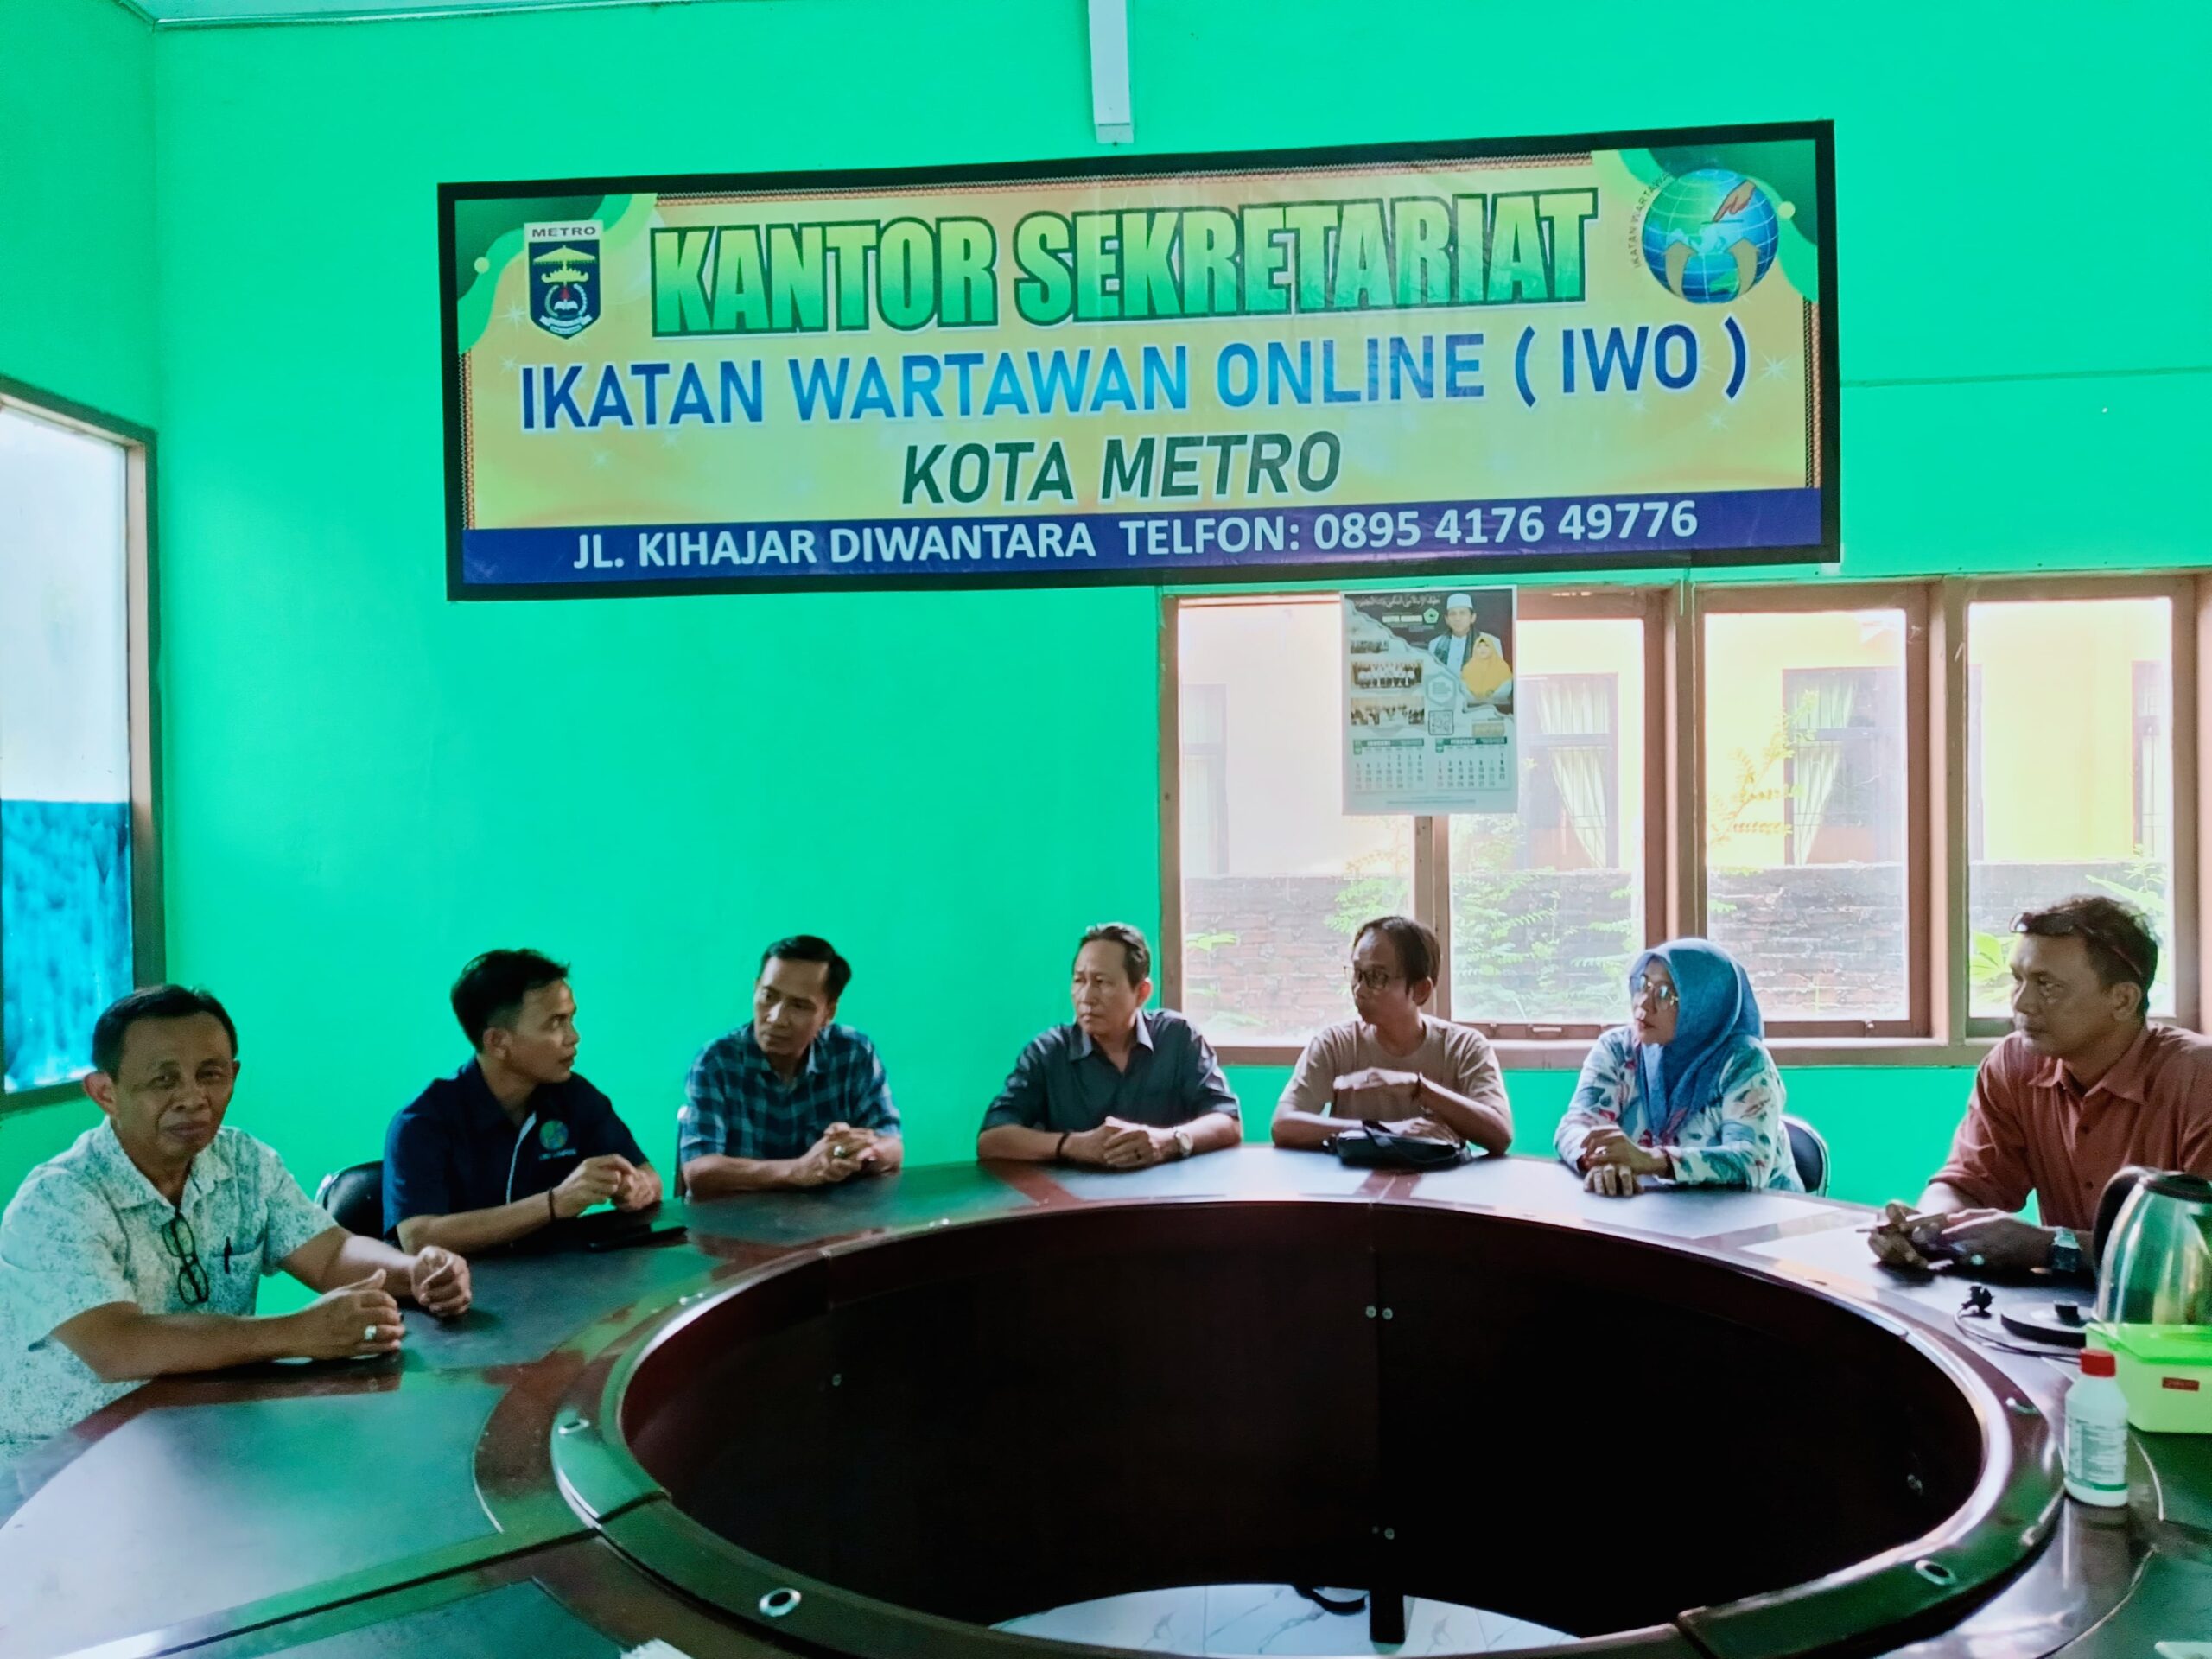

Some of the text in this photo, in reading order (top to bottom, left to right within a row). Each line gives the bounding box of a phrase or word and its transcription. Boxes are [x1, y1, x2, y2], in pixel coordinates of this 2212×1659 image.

[532, 226, 596, 238] METRO
[652, 188, 1599, 337] KANTOR SEKRETARIAT
[522, 359, 763, 430] IKATAN
[788, 346, 1187, 422] WARTAWAN
[1217, 334, 1484, 408] ONLINE
[1562, 323, 1699, 394] IWO
[903, 430, 1341, 505] KOTA METRO
[573, 499, 1699, 569] JL. KIHAJAR DIWANTARA TELFON: 0895 4176 49776
